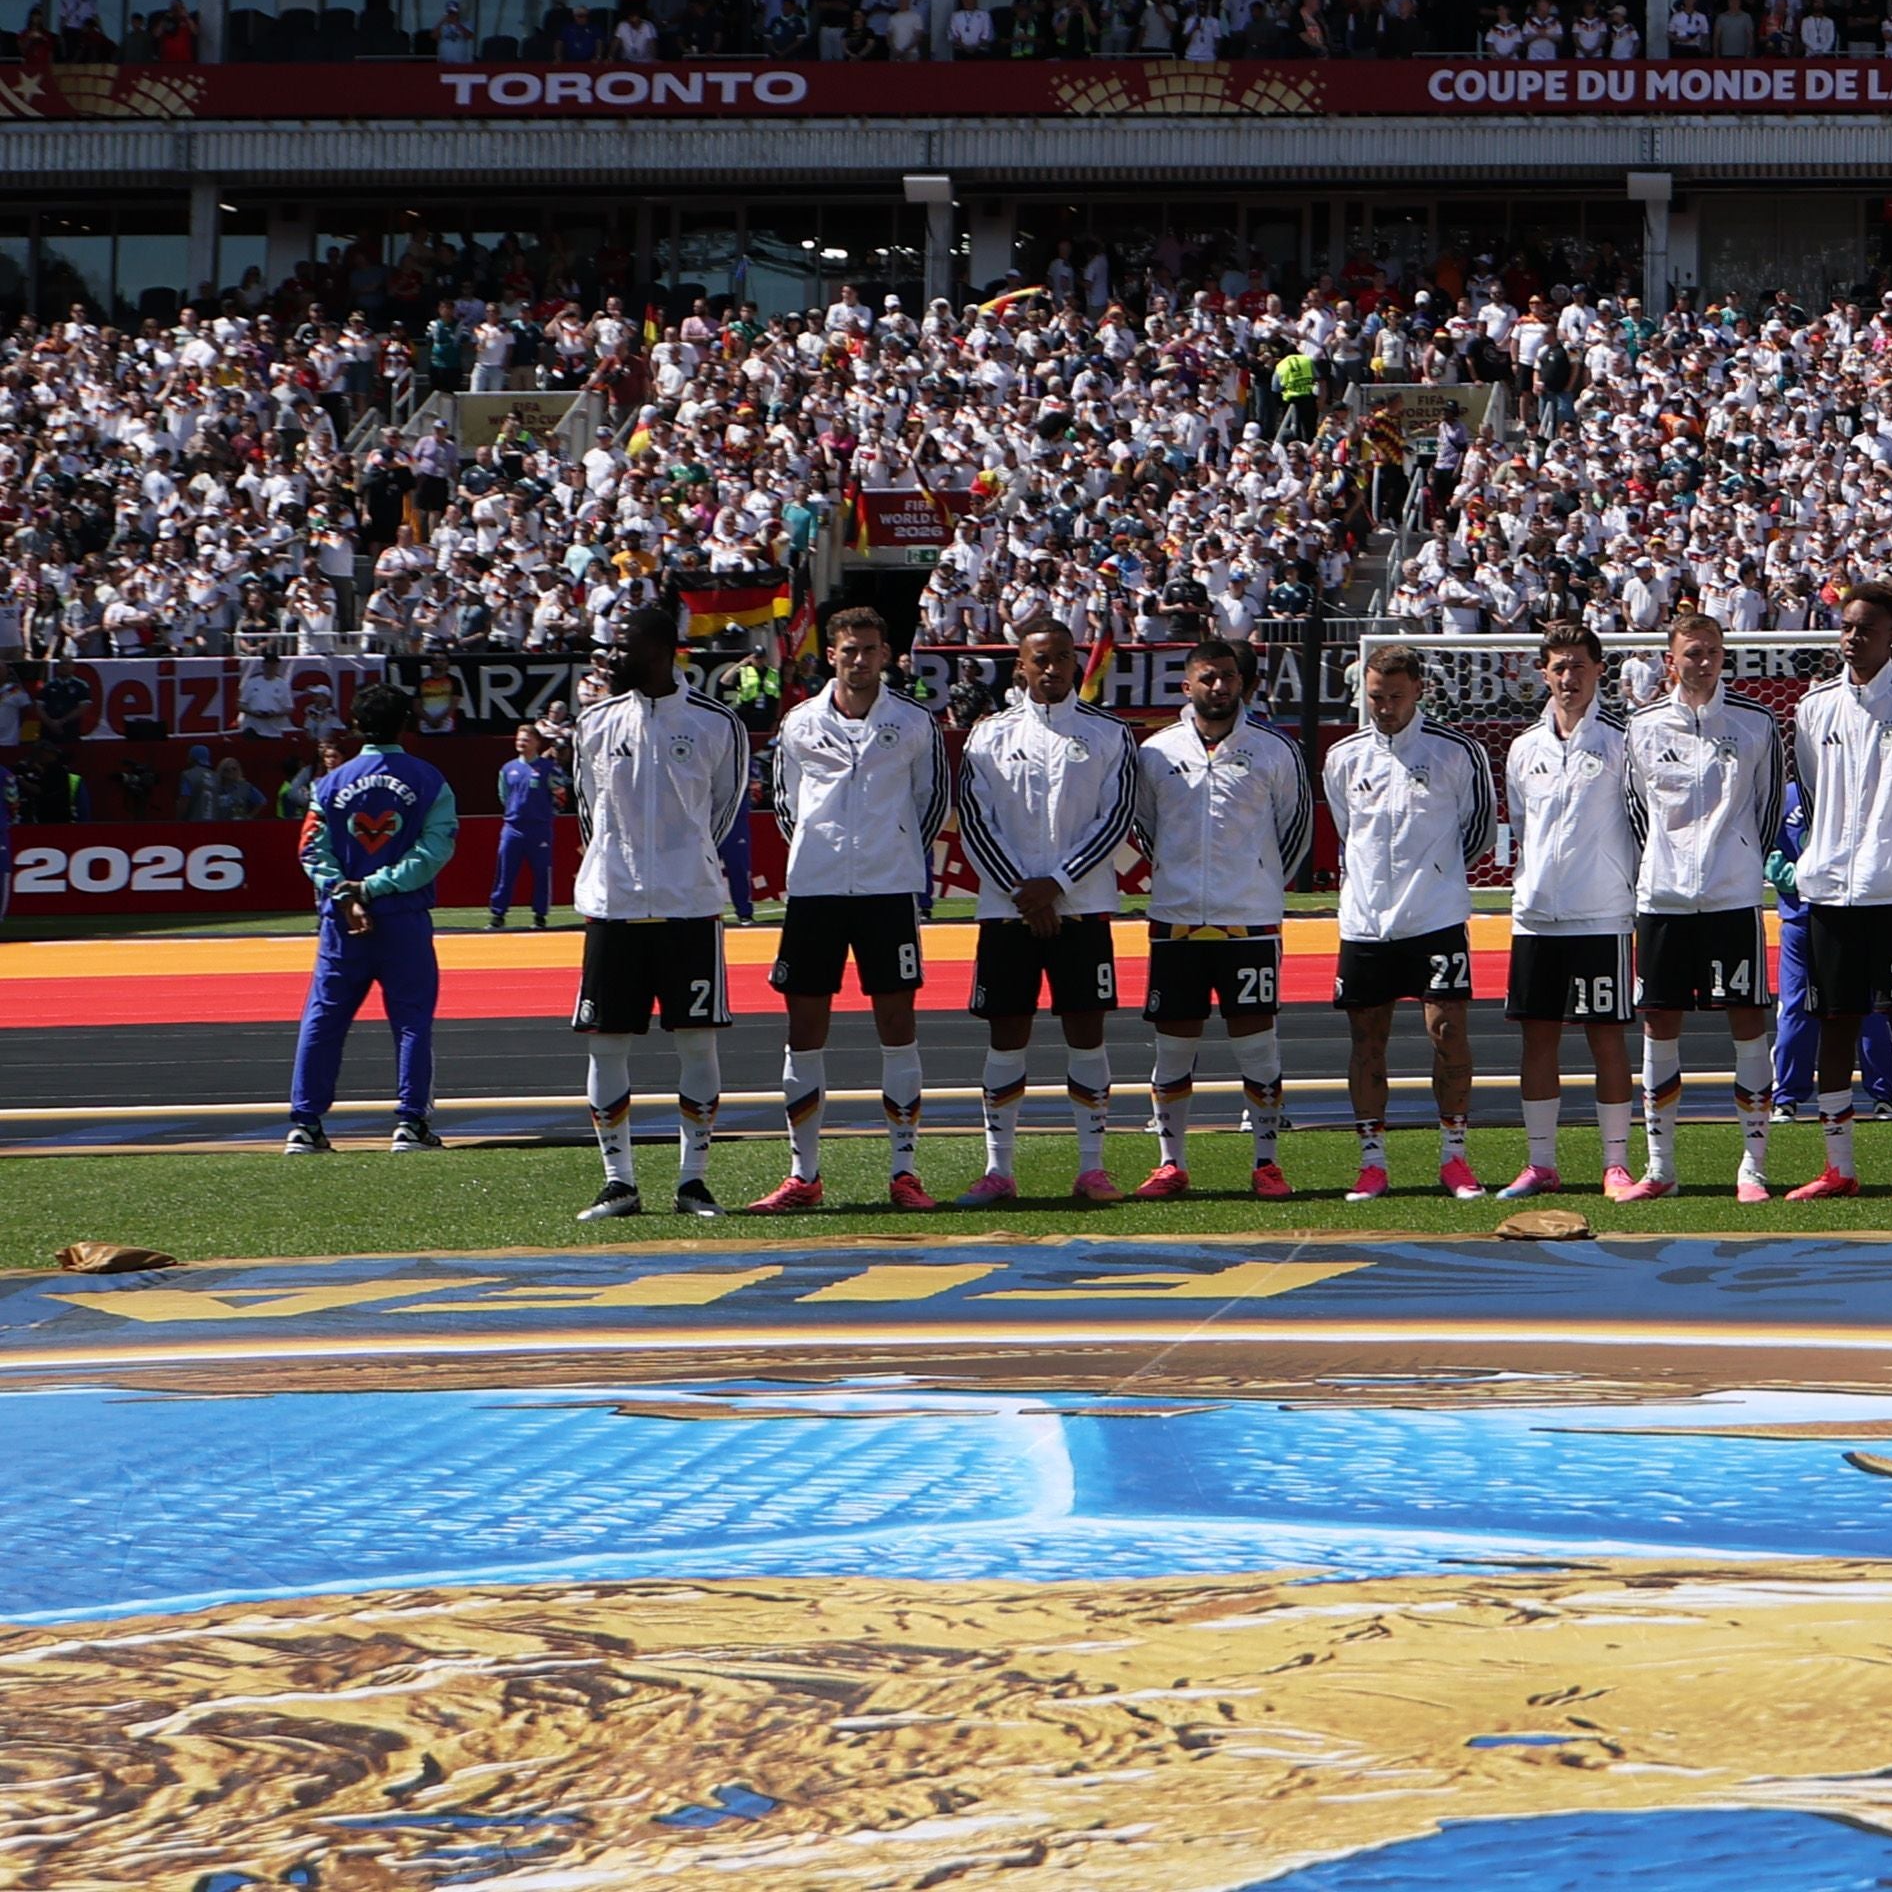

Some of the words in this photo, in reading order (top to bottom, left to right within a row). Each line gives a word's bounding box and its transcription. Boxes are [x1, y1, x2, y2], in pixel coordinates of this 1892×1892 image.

[439, 70, 808, 106] TORONTO
[1427, 68, 1568, 102] COUPE
[1575, 69, 1635, 102] DU
[1646, 68, 1796, 102] MONDE
[1805, 69, 1859, 101] DE
[880, 512, 931, 525] WORLD
[894, 526, 945, 538] 2026
[332, 773, 419, 809] VOLUNTEER
[13, 844, 246, 893] 2026
[898, 942, 918, 980] 8
[1429, 951, 1470, 990] 22
[1710, 958, 1751, 997] 14
[689, 979, 711, 1017] 2
[1097, 963, 1114, 1000] 9
[1236, 966, 1276, 1005] 26
[1573, 976, 1614, 1014] 16
[40, 1261, 1377, 1322] FIFA
